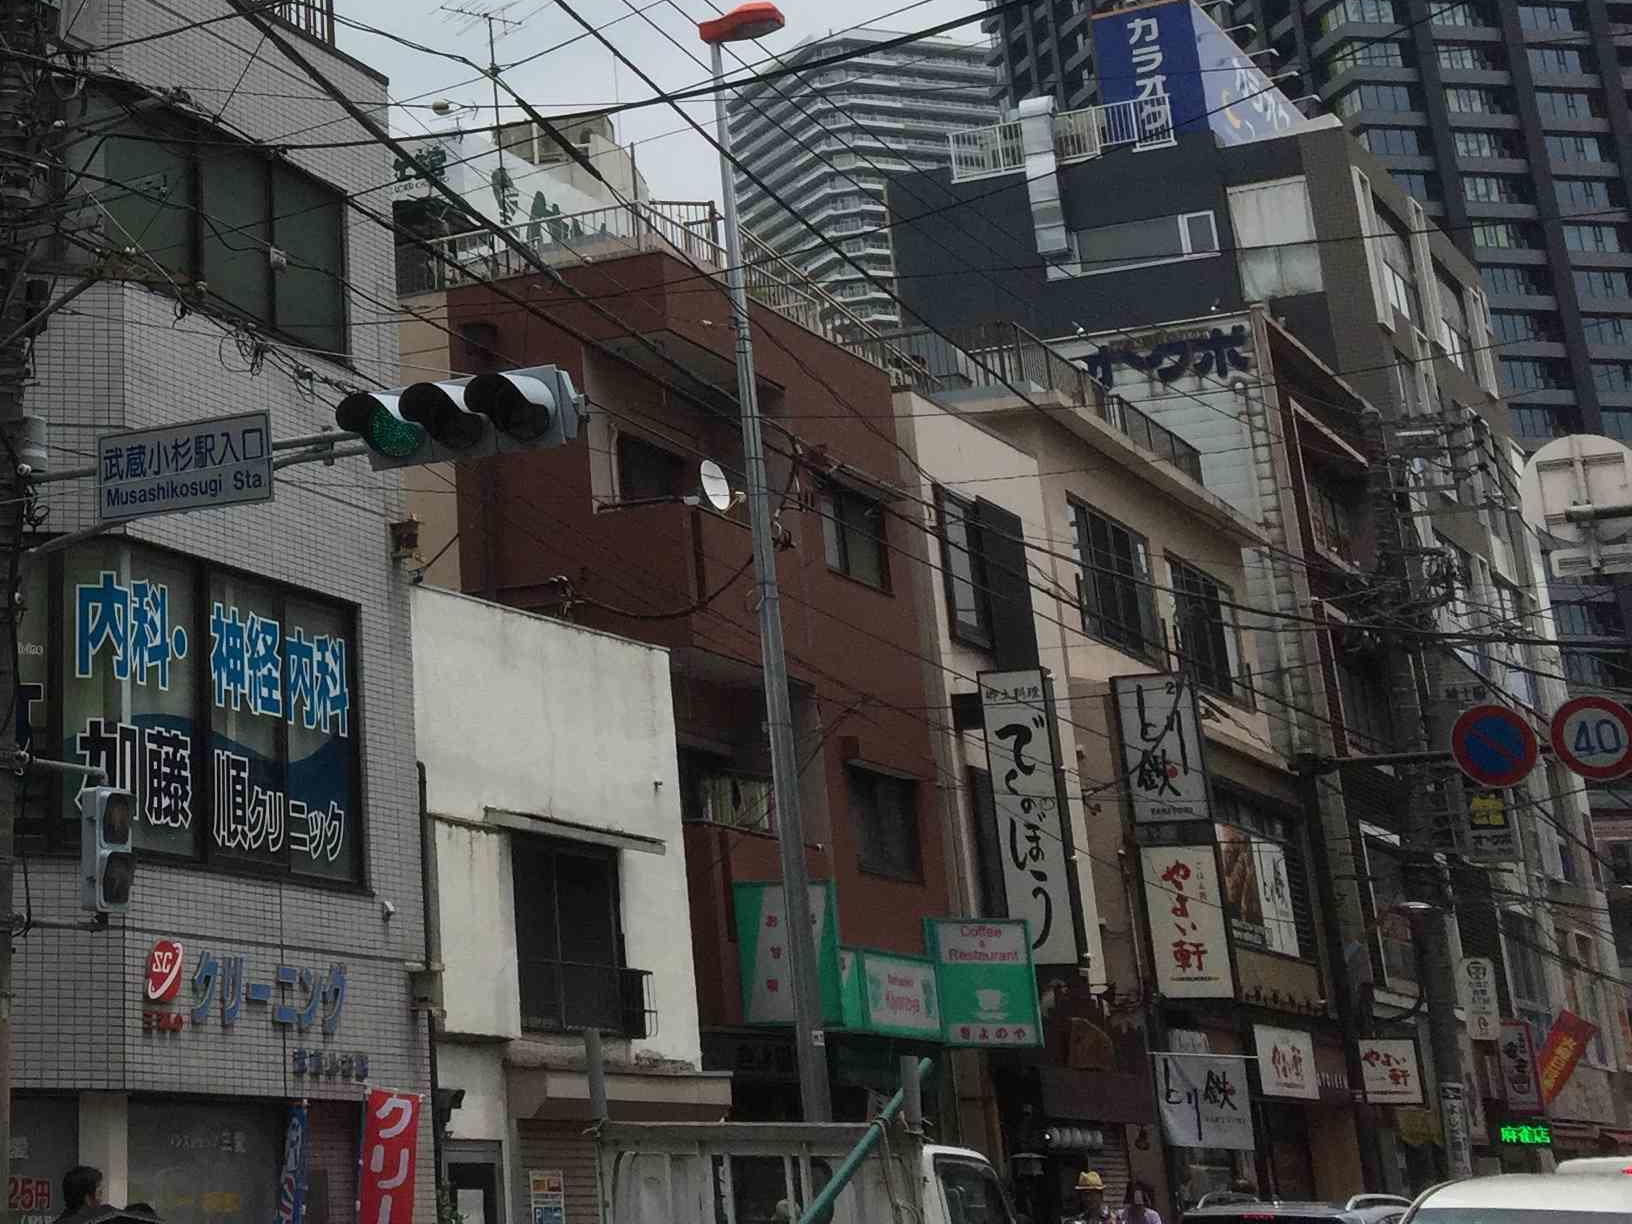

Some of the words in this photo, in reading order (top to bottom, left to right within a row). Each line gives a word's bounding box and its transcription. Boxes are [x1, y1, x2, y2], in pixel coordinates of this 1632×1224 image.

[103, 427, 265, 481] 武蔵小杉駅入口
[106, 473, 224, 507] Musashikosugi
[1575, 719, 1620, 752] 40
[960, 926, 1002, 938] Coffee
[949, 948, 1020, 961] Restaurant
[191, 951, 347, 1031] クリーニング
